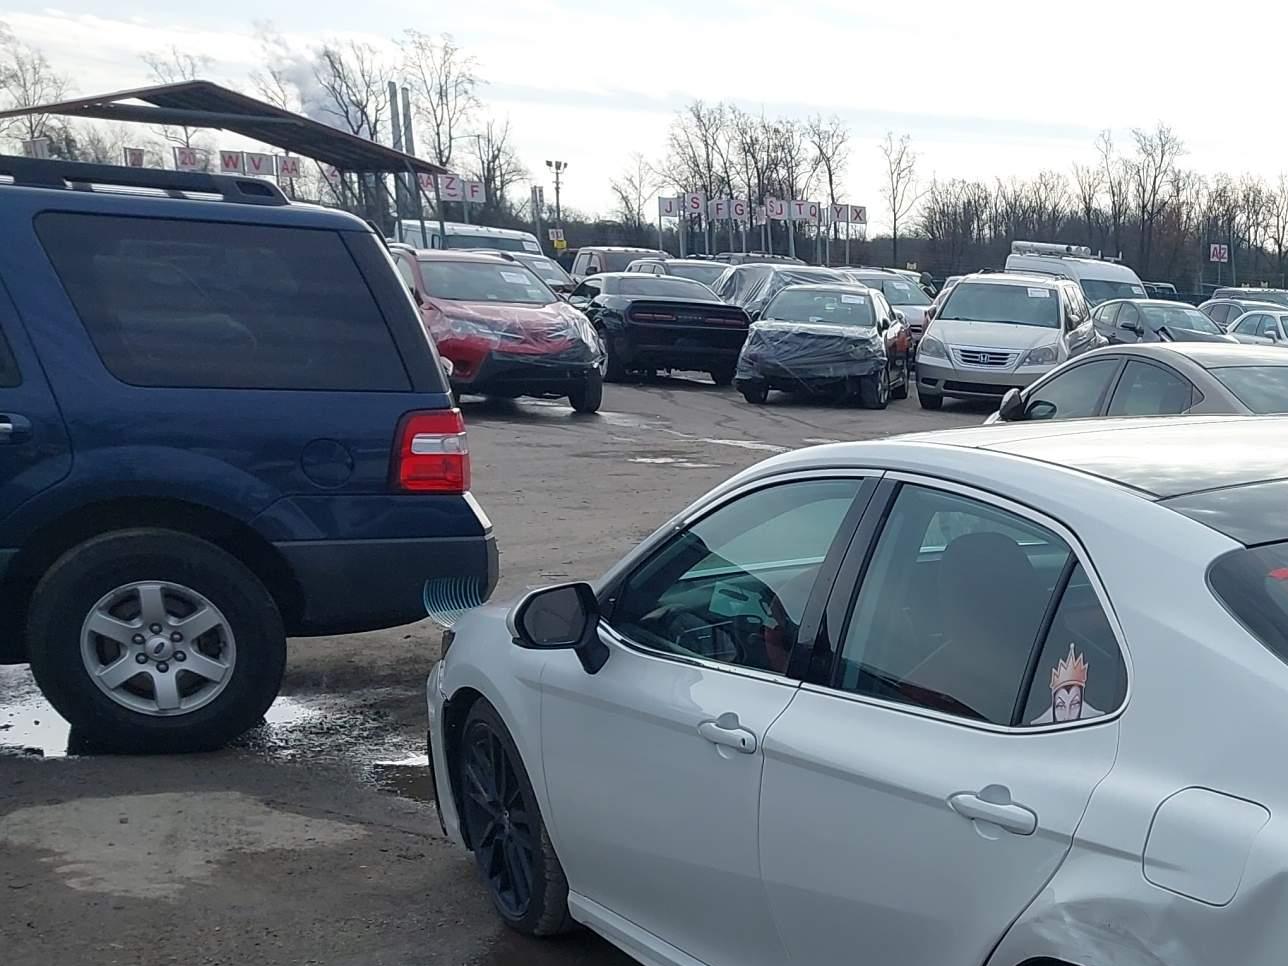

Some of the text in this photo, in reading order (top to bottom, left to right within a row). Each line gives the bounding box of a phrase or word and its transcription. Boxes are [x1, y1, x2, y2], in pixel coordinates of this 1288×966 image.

[222, 154, 239, 169] W
[250, 156, 263, 170] V
[281, 160, 298, 174] AA
[470, 184, 479, 198] F
[664, 201, 673, 214] J
[690, 197, 700, 209] S
[716, 203, 724, 216] F
[734, 203, 745, 216] G
[795, 203, 804, 215] T
[809, 204, 817, 218] Q
[834, 206, 843, 219] Y
[854, 209, 863, 221] X
